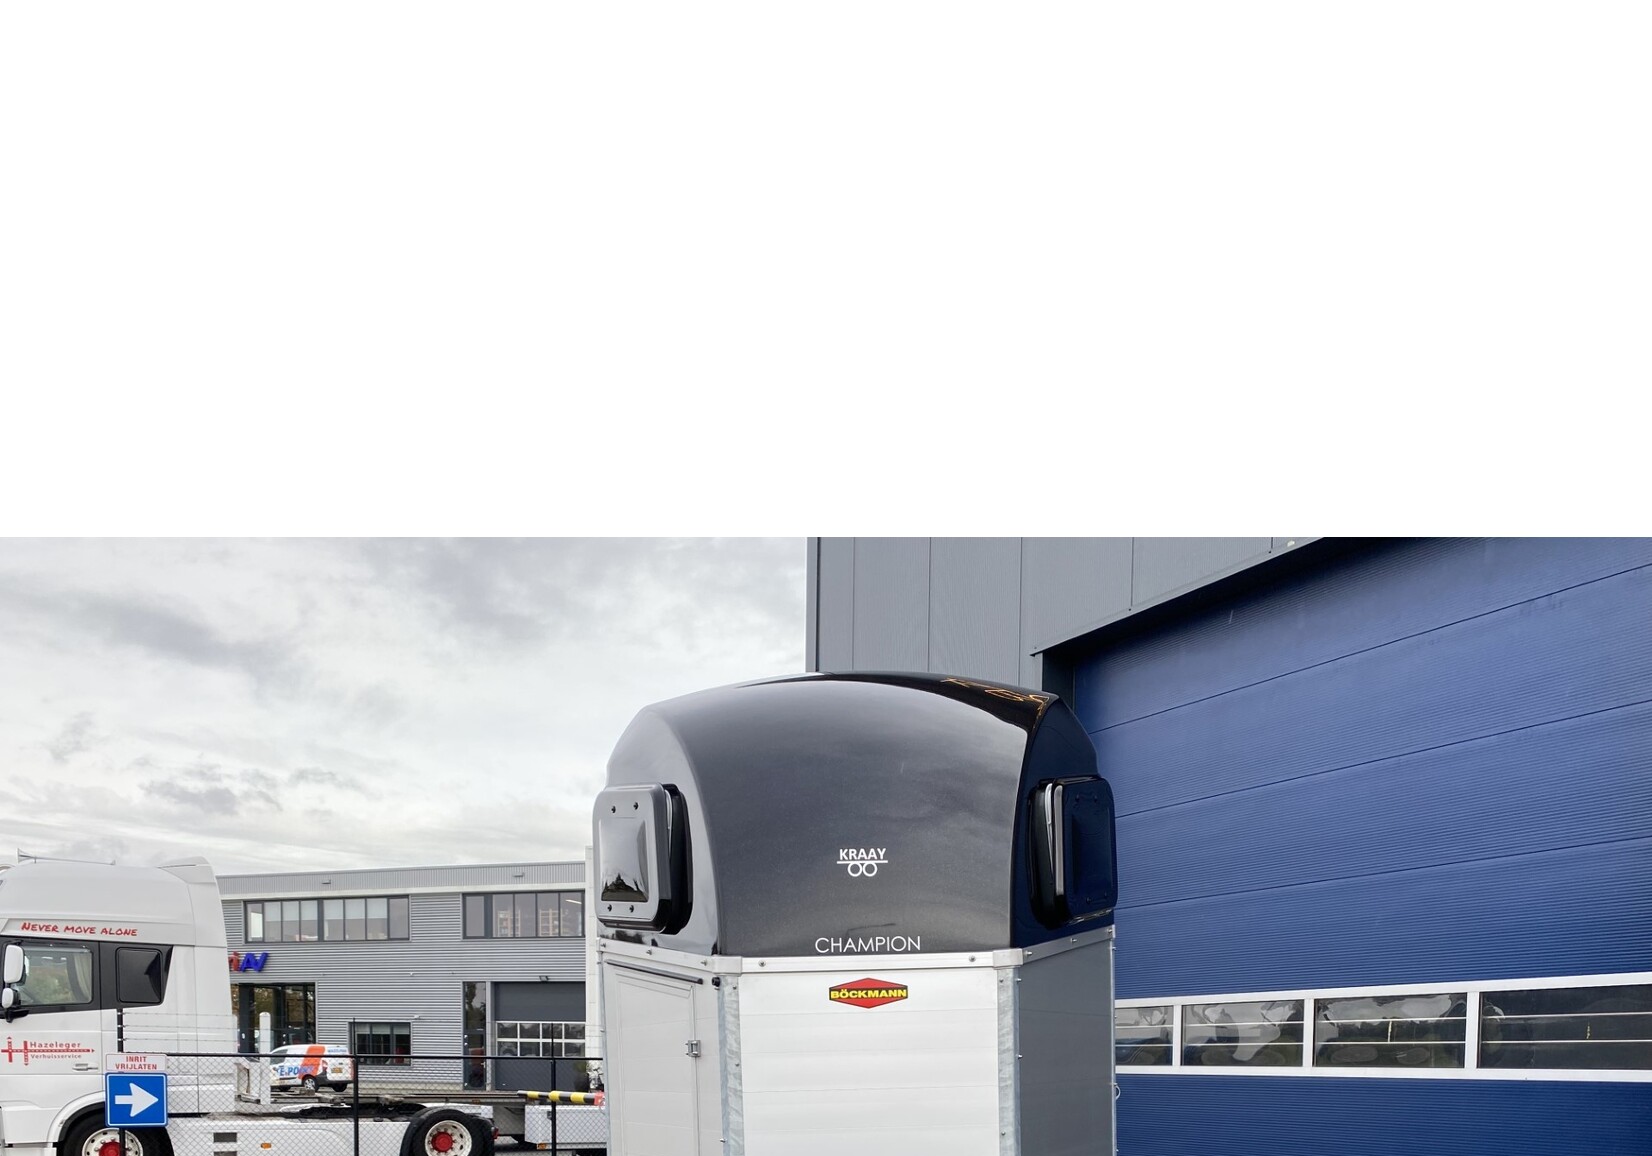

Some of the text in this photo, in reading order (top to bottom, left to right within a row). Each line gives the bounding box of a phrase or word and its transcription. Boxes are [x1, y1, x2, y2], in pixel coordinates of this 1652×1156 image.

[839, 848, 887, 860] KRAAY
[21, 922, 138, 937] NEVER MOVE ALONE
[815, 936, 921, 953] CHAMPION
[830, 989, 907, 999] BÖCKMANN
[30, 1041, 81, 1050] Hazeleger
[125, 1055, 147, 1063] INRIT
